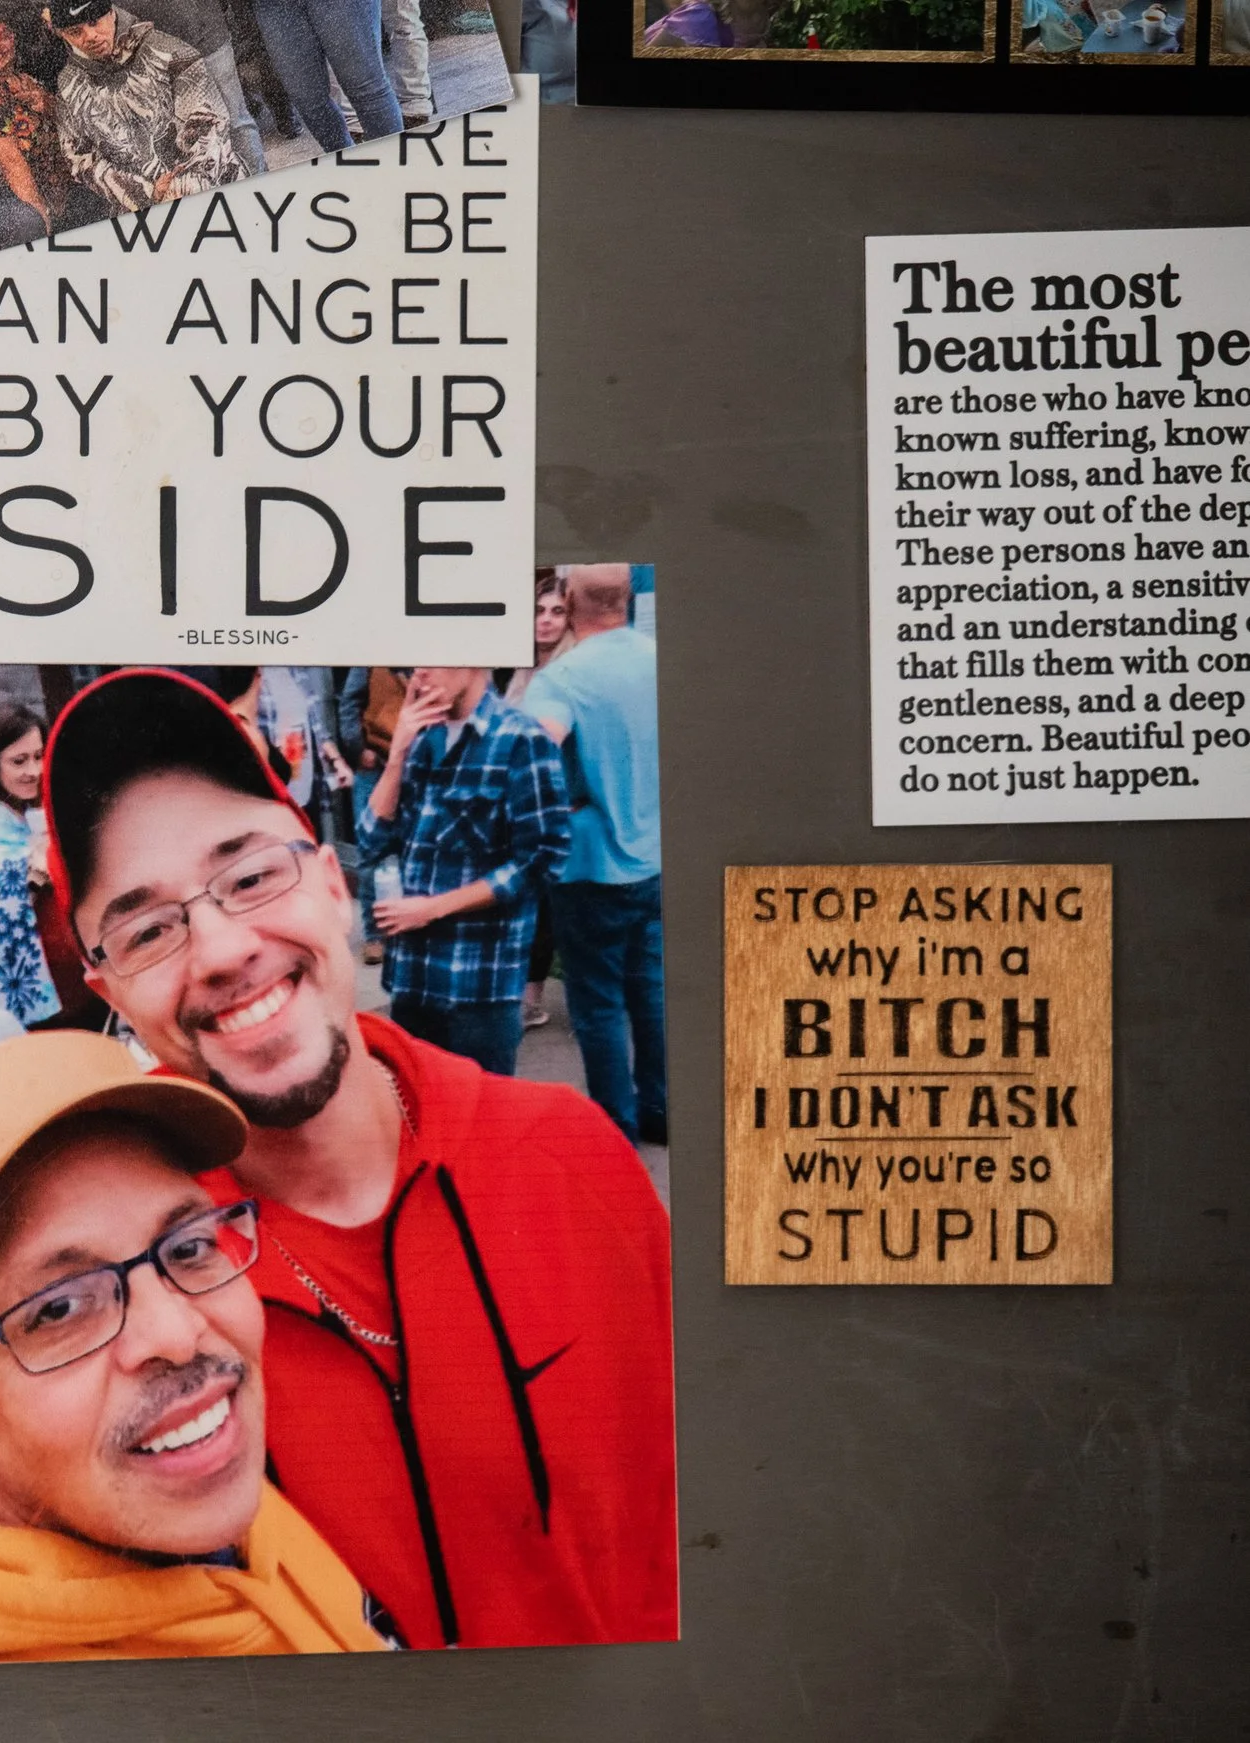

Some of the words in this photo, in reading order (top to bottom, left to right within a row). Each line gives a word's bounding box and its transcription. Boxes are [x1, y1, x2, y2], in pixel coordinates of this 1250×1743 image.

[24, 191, 358, 254] WAYS
[404, 191, 507, 254] BE
[893, 259, 1015, 315] The
[1030, 262, 1182, 312] most
[165, 278, 508, 345] ANGEL
[893, 314, 1162, 375] beautiful
[1176, 329, 1250, 381] pe
[189, 374, 506, 459] YOUR
[894, 395, 943, 416] are
[950, 385, 1037, 414] those
[1042, 382, 1108, 412] who
[1115, 381, 1186, 410] have
[894, 424, 1001, 453] known
[1009, 420, 1157, 455] suffering,
[1163, 418, 1250, 447] know
[895, 462, 1002, 491] known
[1009, 459, 1078, 492] loss,
[1085, 456, 1145, 487] and
[1151, 456, 1223, 485] have
[894, 500, 972, 529] their
[976, 506, 1036, 533] way
[1043, 500, 1096, 525] out
[1102, 494, 1138, 524] of
[1140, 493, 1191, 523] the
[896, 537, 994, 566] These
[1001, 542, 1126, 571] persons
[1133, 532, 1204, 561] have
[1212, 539, 1250, 560] an
[896, 573, 1099, 611] appreciation,
[1106, 580, 1124, 600] a
[1132, 569, 1250, 599] sensitiv
[178, 629, 299, 645] -BLESSING-
[897, 612, 956, 642] and
[963, 621, 1001, 641] an
[1008, 607, 1238, 642] understanding
[897, 651, 959, 680] that
[966, 649, 1025, 678] fills
[1032, 648, 1115, 677] them
[1120, 645, 1190, 675] with
[898, 688, 1070, 725] gentleness,
[1077, 684, 1136, 714] and
[1144, 692, 1162, 712] a
[1169, 682, 1246, 718] deep
[899, 733, 1033, 755] concern.
[1041, 720, 1185, 752] Beautiful
[1192, 727, 1250, 756] peo
[900, 764, 939, 793] do
[947, 767, 1000, 792] not
[1004, 763, 1066, 797] just
[1073, 760, 1200, 796] happen.
[753, 886, 878, 923] STOP
[898, 886, 1083, 923] ASKING
[806, 938, 900, 987] why
[918, 936, 984, 977] i'm
[1000, 945, 1030, 977] a
[783, 997, 1051, 1059] BITCH
[754, 1087, 767, 1129] I
[788, 1085, 950, 1129] DON'T
[967, 1084, 1078, 1129] ASK
[876, 1151, 997, 1191] you're
[1009, 1155, 1052, 1184] so
[778, 1207, 1059, 1262] STUPID
